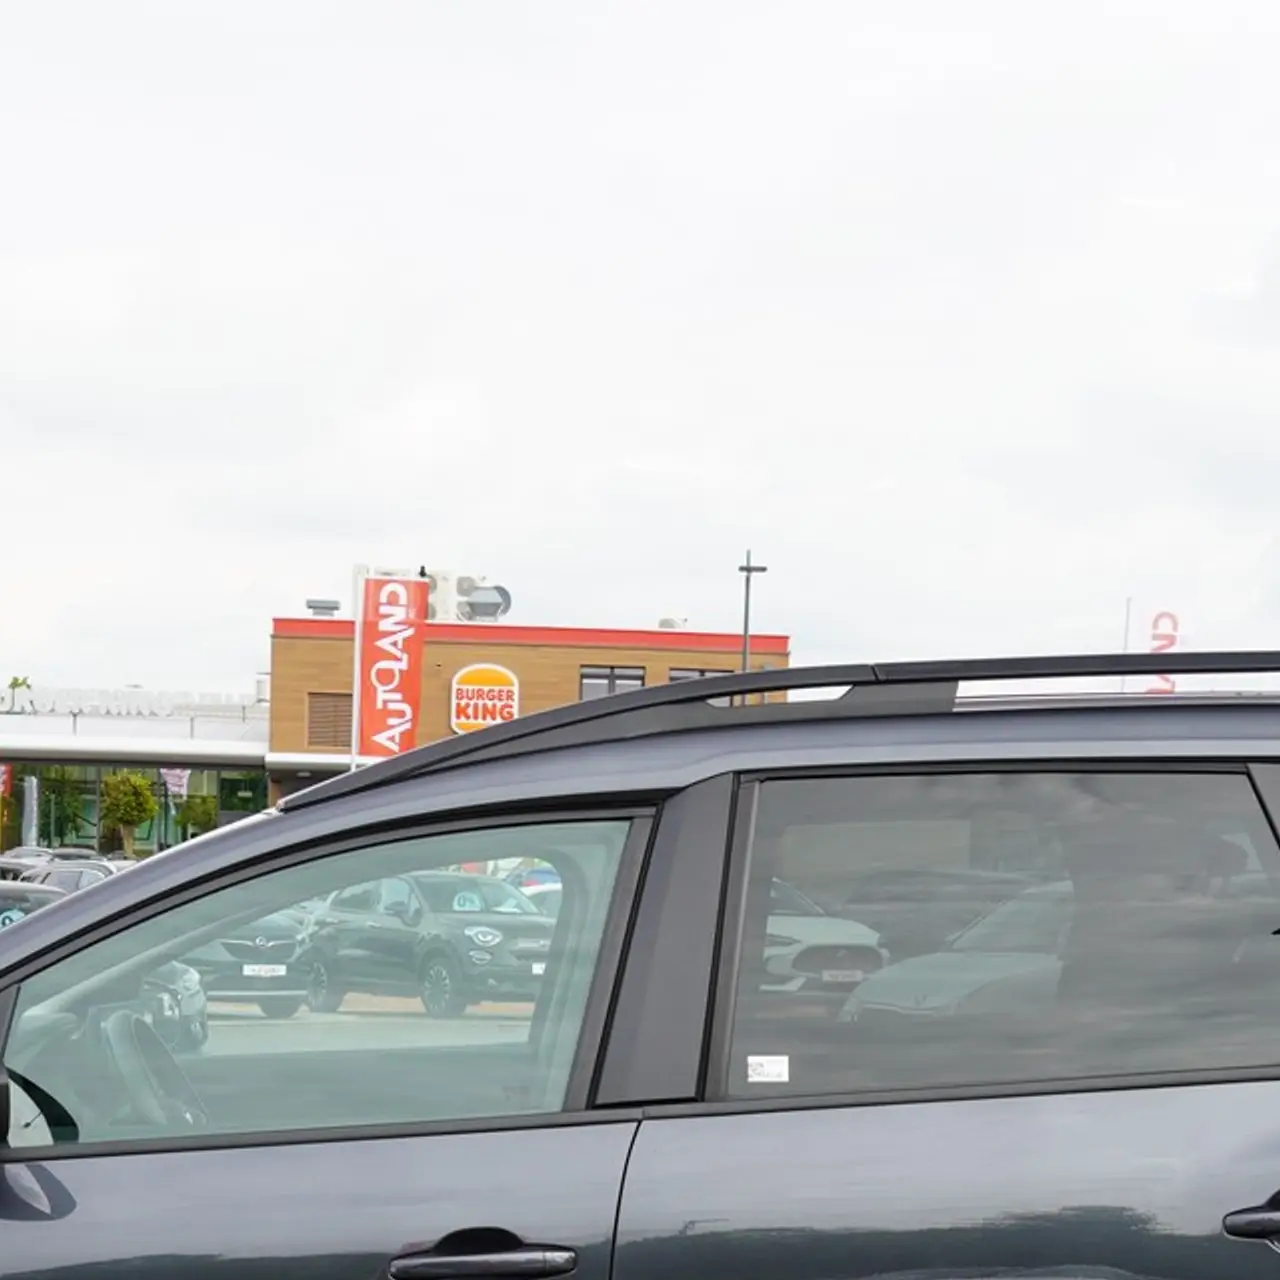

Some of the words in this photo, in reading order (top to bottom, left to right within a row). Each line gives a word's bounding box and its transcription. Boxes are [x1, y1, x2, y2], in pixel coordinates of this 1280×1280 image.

[371, 582, 416, 753] AUTOLAND
[455, 687, 515, 702] BURGER
[455, 702, 515, 722] KING
